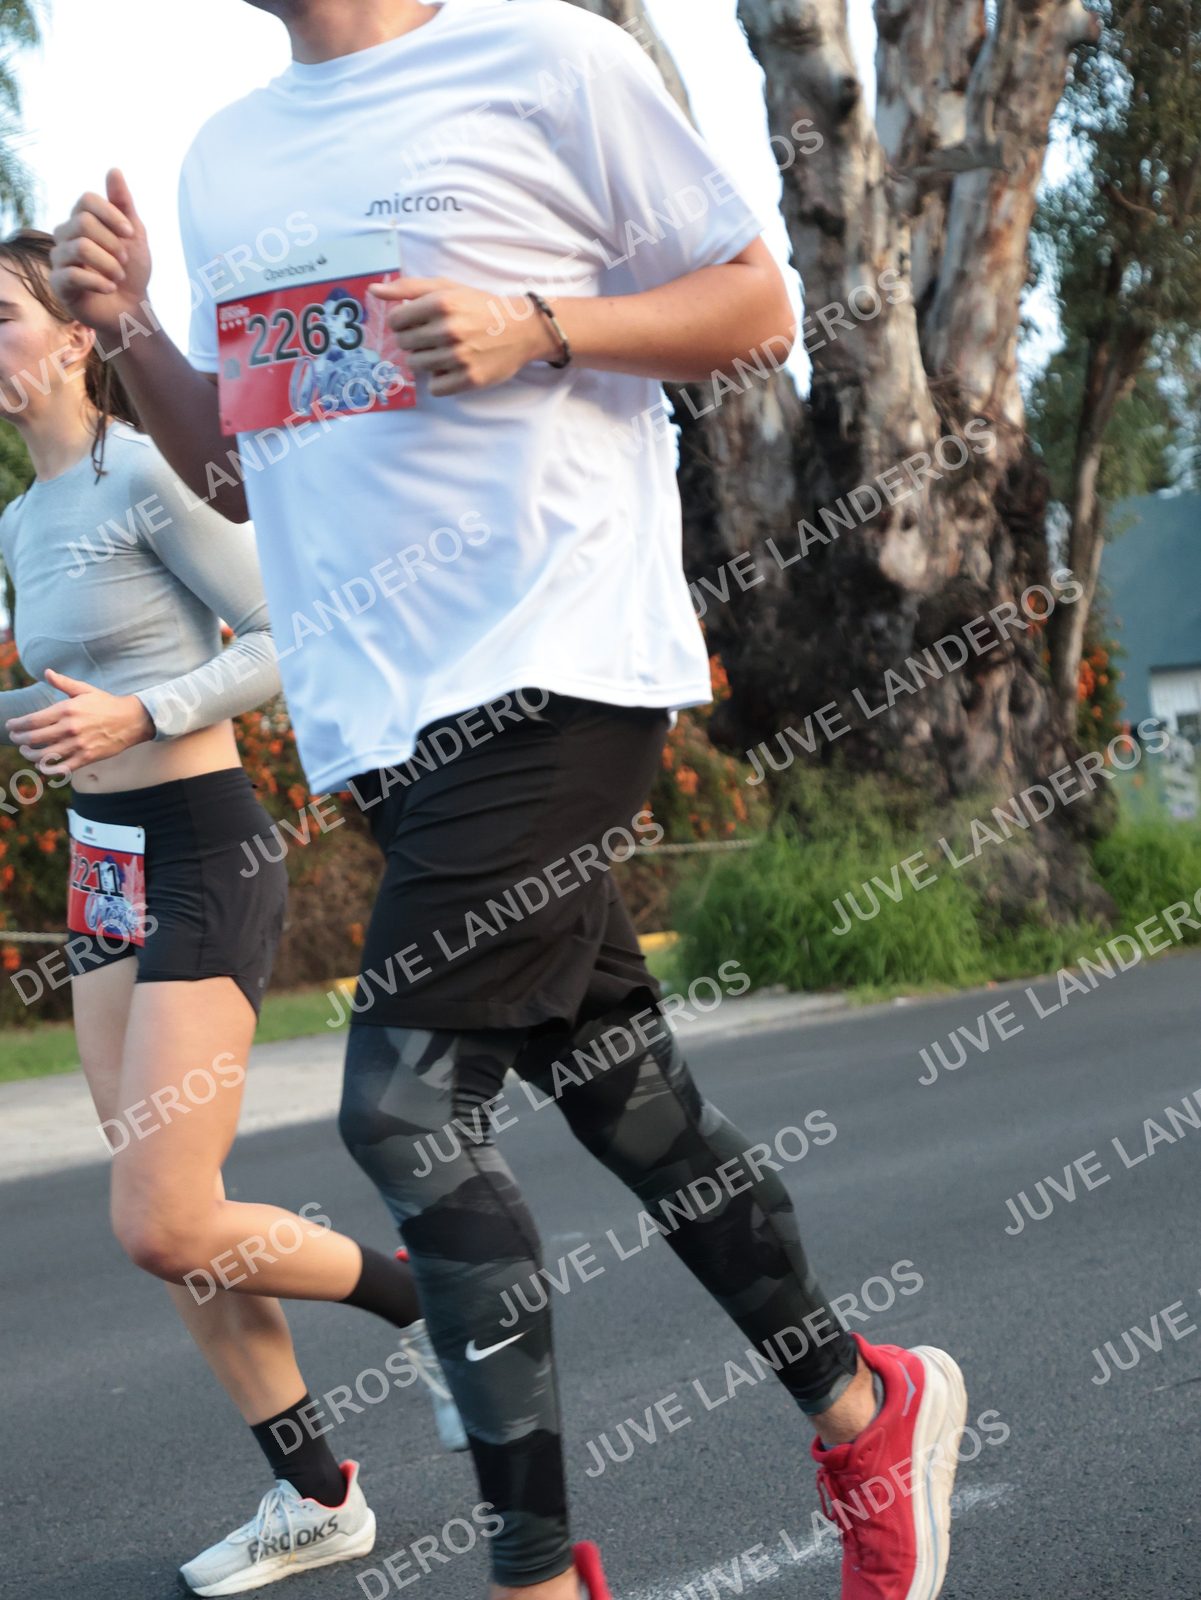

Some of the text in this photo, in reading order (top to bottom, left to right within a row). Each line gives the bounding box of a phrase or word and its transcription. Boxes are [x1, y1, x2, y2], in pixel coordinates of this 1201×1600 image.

[365, 192, 463, 216] micron
[247, 298, 364, 368] 2263
[247, 1514, 338, 1564] BROOKS
